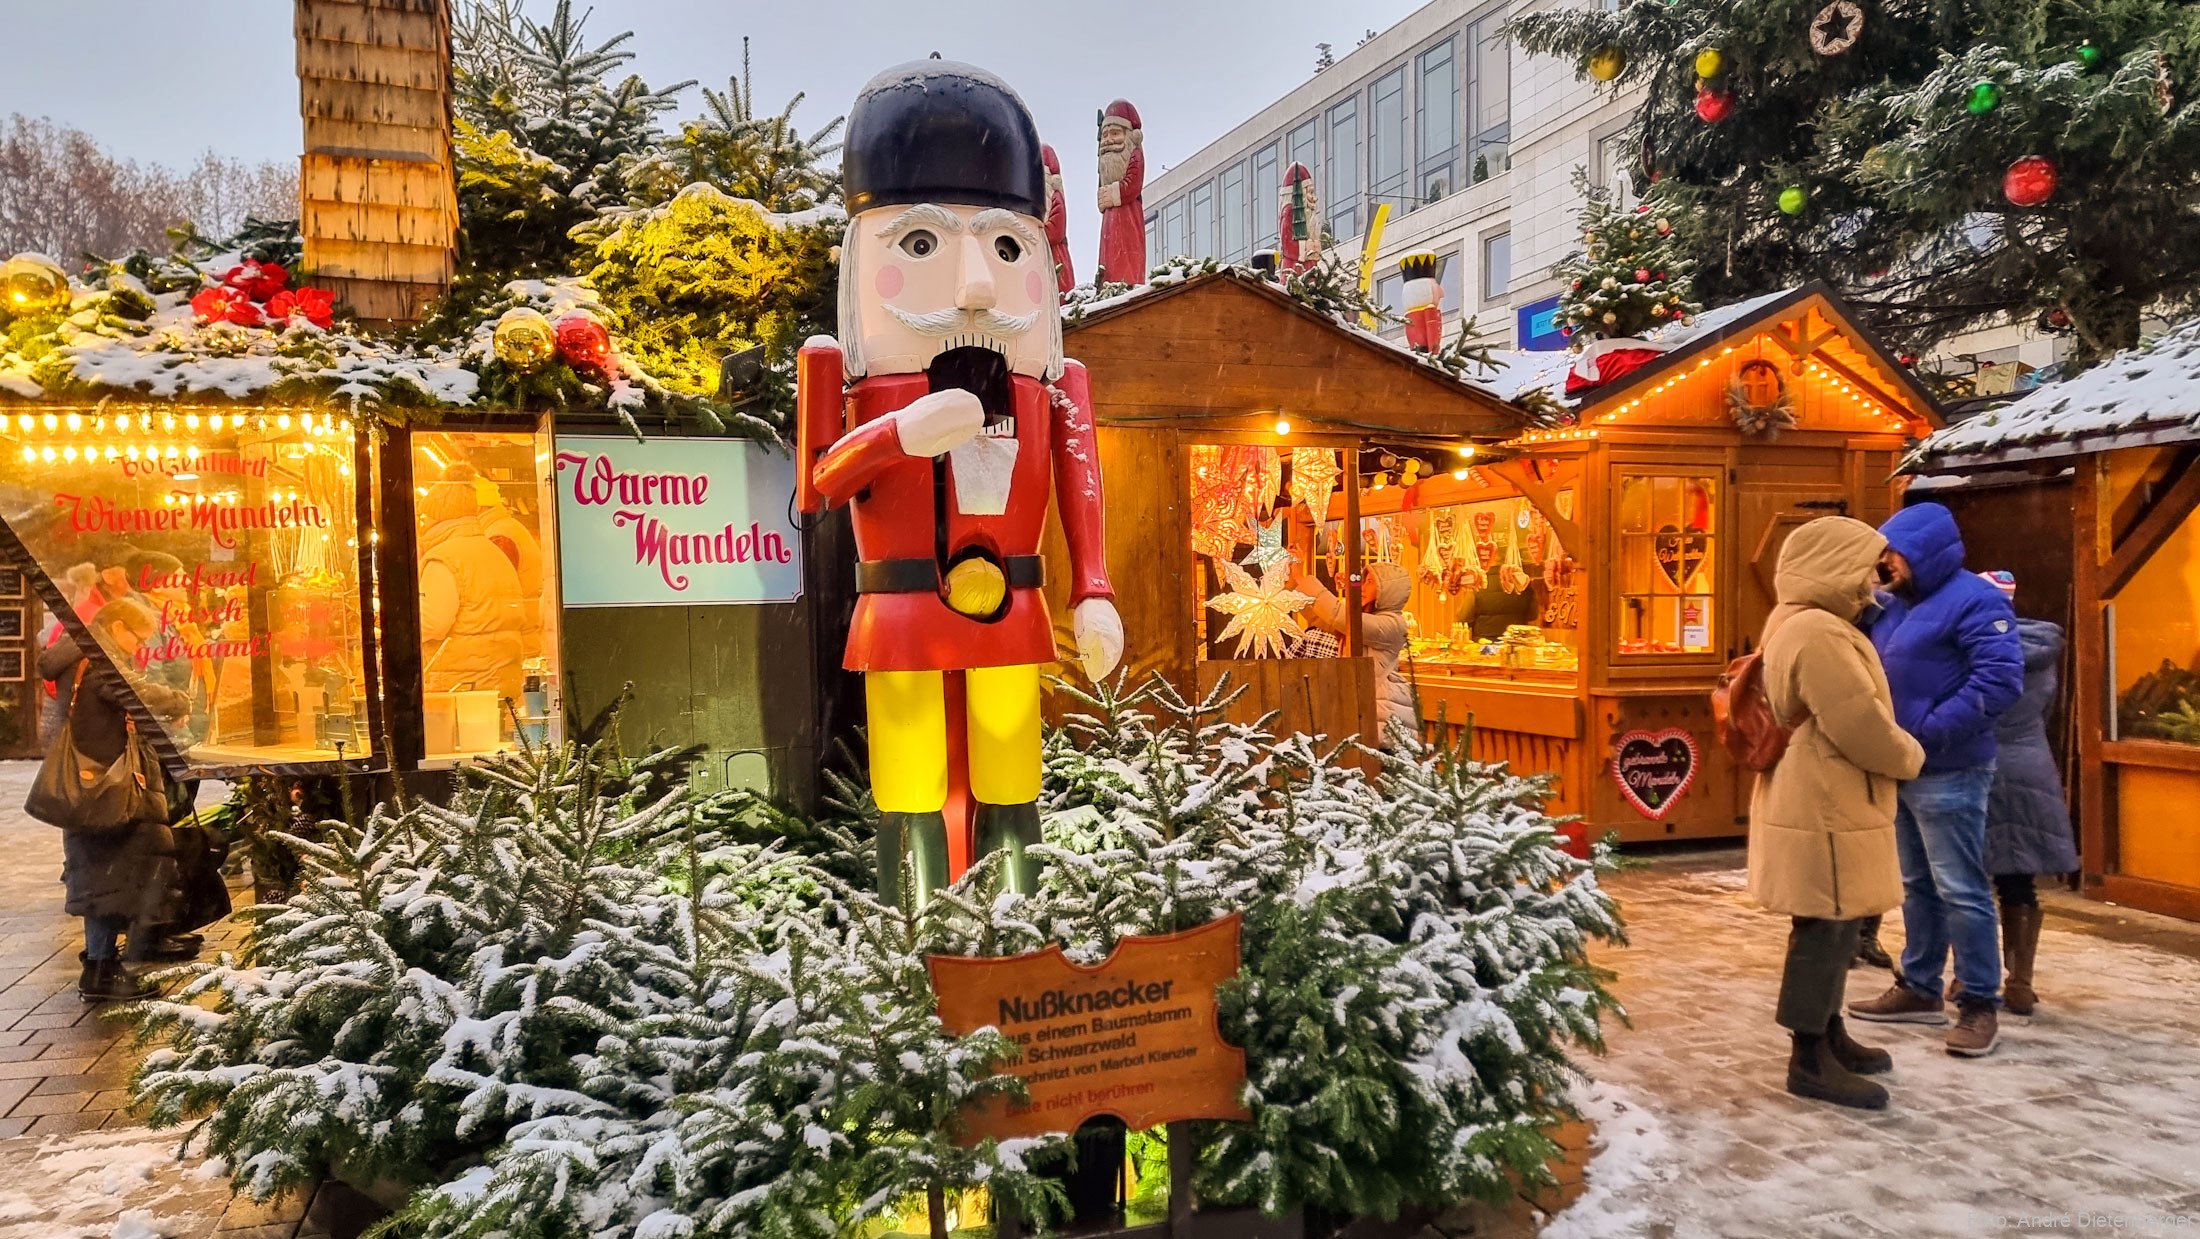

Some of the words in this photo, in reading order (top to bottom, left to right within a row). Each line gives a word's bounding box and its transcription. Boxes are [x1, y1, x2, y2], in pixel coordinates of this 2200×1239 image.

[556, 450, 709, 506] Warme
[53, 493, 185, 534] Wiener
[171, 489, 327, 550] Mandeln
[613, 509, 792, 591] Mandeln
[138, 562, 257, 596] laufend
[159, 597, 242, 635] frisch
[999, 979, 1174, 1025] Nußknacker
[1036, 1023, 1088, 1043] einem
[1092, 1006, 1192, 1034] Baumstamm
[1028, 1033, 1136, 1064] Schwarzwald
[1074, 1063, 1098, 1078] von
[1046, 1090, 1083, 1111] nicht
[1088, 1081, 1154, 1106] berühren
